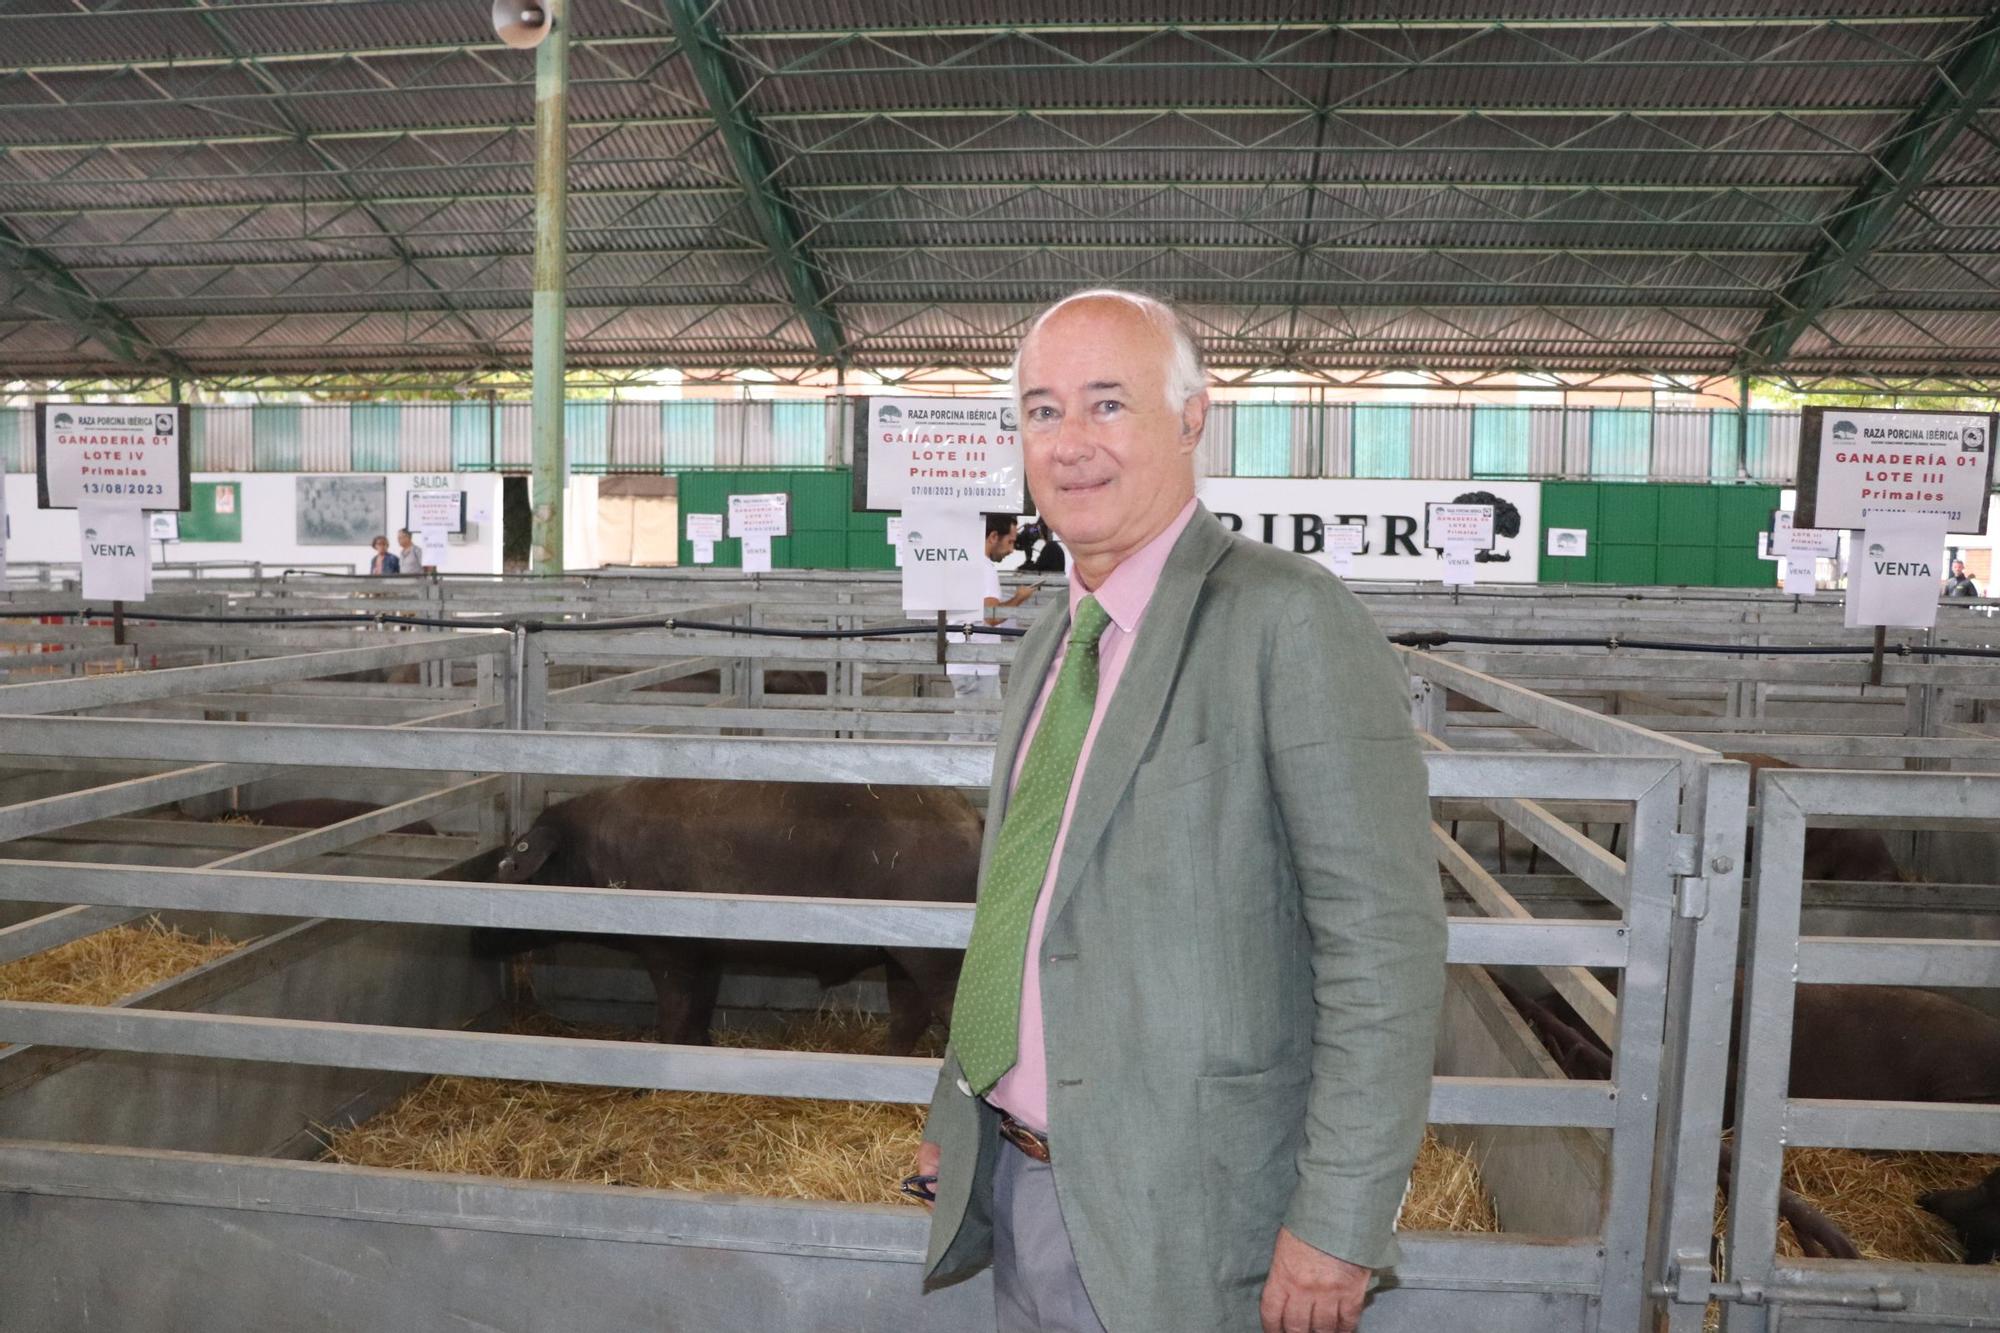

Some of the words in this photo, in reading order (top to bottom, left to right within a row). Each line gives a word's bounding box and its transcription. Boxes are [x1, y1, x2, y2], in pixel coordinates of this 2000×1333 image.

[908, 409, 928, 419] RAZA
[930, 410, 964, 420] PORCINA
[967, 409, 997, 420] IBÉRICA
[78, 416, 95, 425] RAZA
[97, 417, 125, 425] PORCINA
[58, 435, 145, 445] GANADERÍA
[152, 436, 169, 445] 01
[883, 433, 987, 445] GANADERÍA
[997, 435, 1015, 445] 01
[1864, 428, 1885, 438] RAZA
[1888, 429, 1924, 440] PORCINA
[1926, 428, 1959, 441] IBÉRICA
[84, 451, 121, 460] LOTE
[129, 451, 144, 460] IV
[912, 451, 956, 461] LOTE
[966, 452, 985, 461] III
[1836, 453, 1947, 466] GANADERÍA
[1957, 456, 1976, 466] 01
[910, 468, 988, 478] Primales
[1866, 472, 1912, 483] LOTE
[1923, 474, 1943, 483] III
[413, 476, 449, 488] SALIDA
[83, 484, 163, 494] 13/08/2023
[956, 488, 961, 498] y
[1862, 489, 1944, 501] Primales
[91, 544, 136, 557] VENTA
[914, 548, 969, 562] VENTA
[1874, 561, 1931, 577] VENTA
